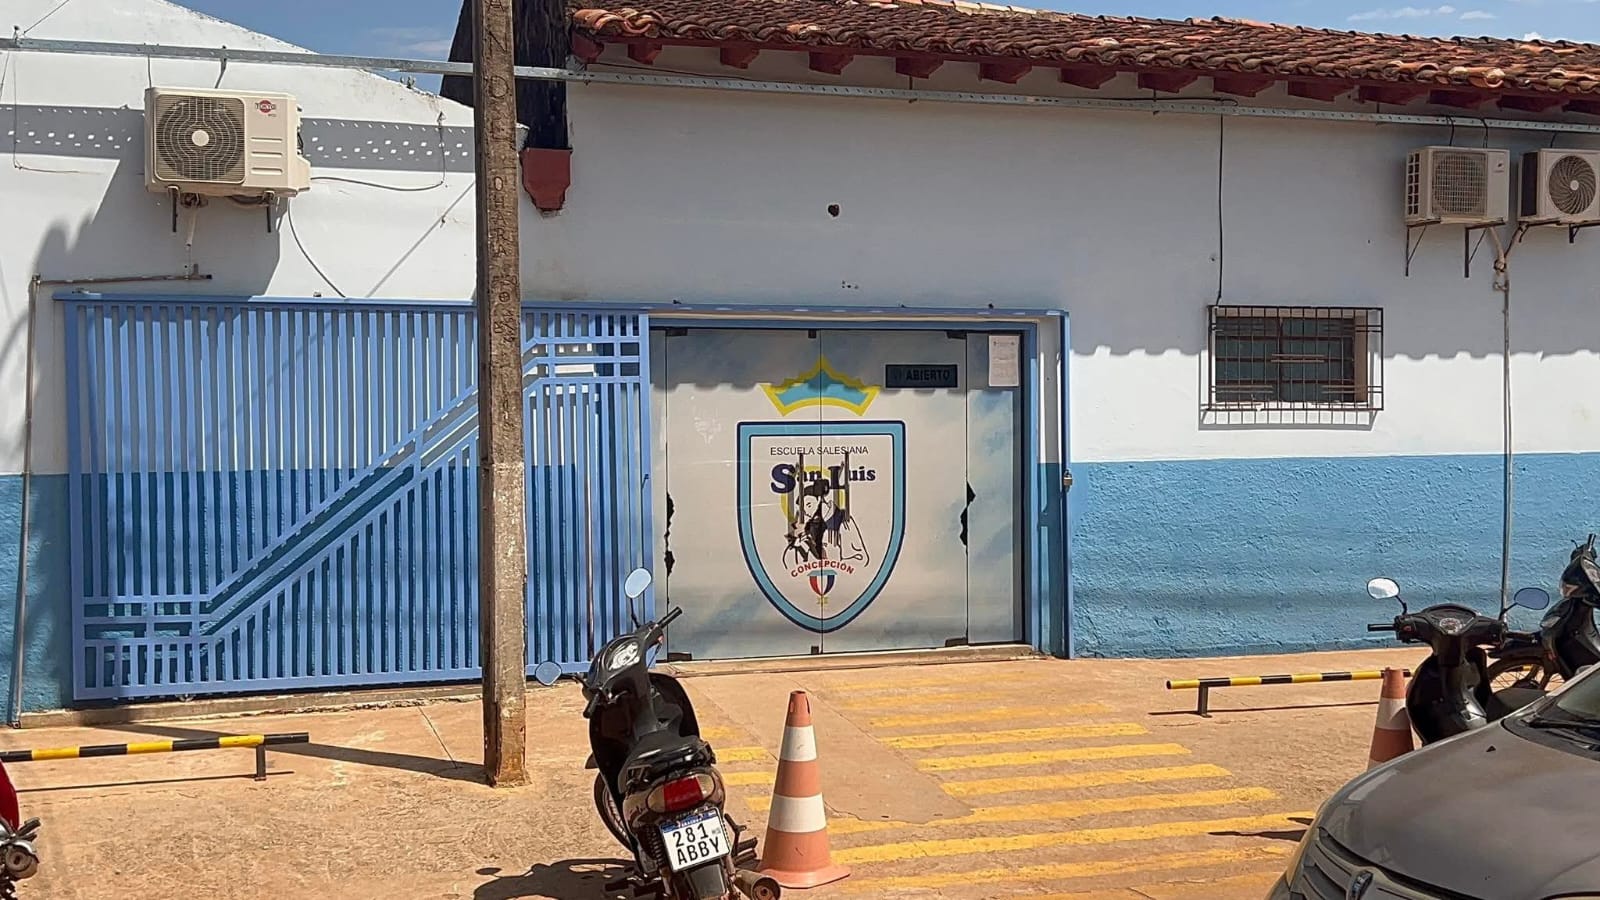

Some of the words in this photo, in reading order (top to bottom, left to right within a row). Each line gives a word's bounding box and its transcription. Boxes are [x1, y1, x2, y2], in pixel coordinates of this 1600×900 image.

[906, 369, 950, 381] ABIERTO
[770, 447, 814, 455] ESCUELA
[816, 446, 869, 454] SALESIANA
[791, 560, 854, 578] CONCEPCIÓN
[672, 823, 708, 848] 281
[677, 836, 719, 865] ABBY
